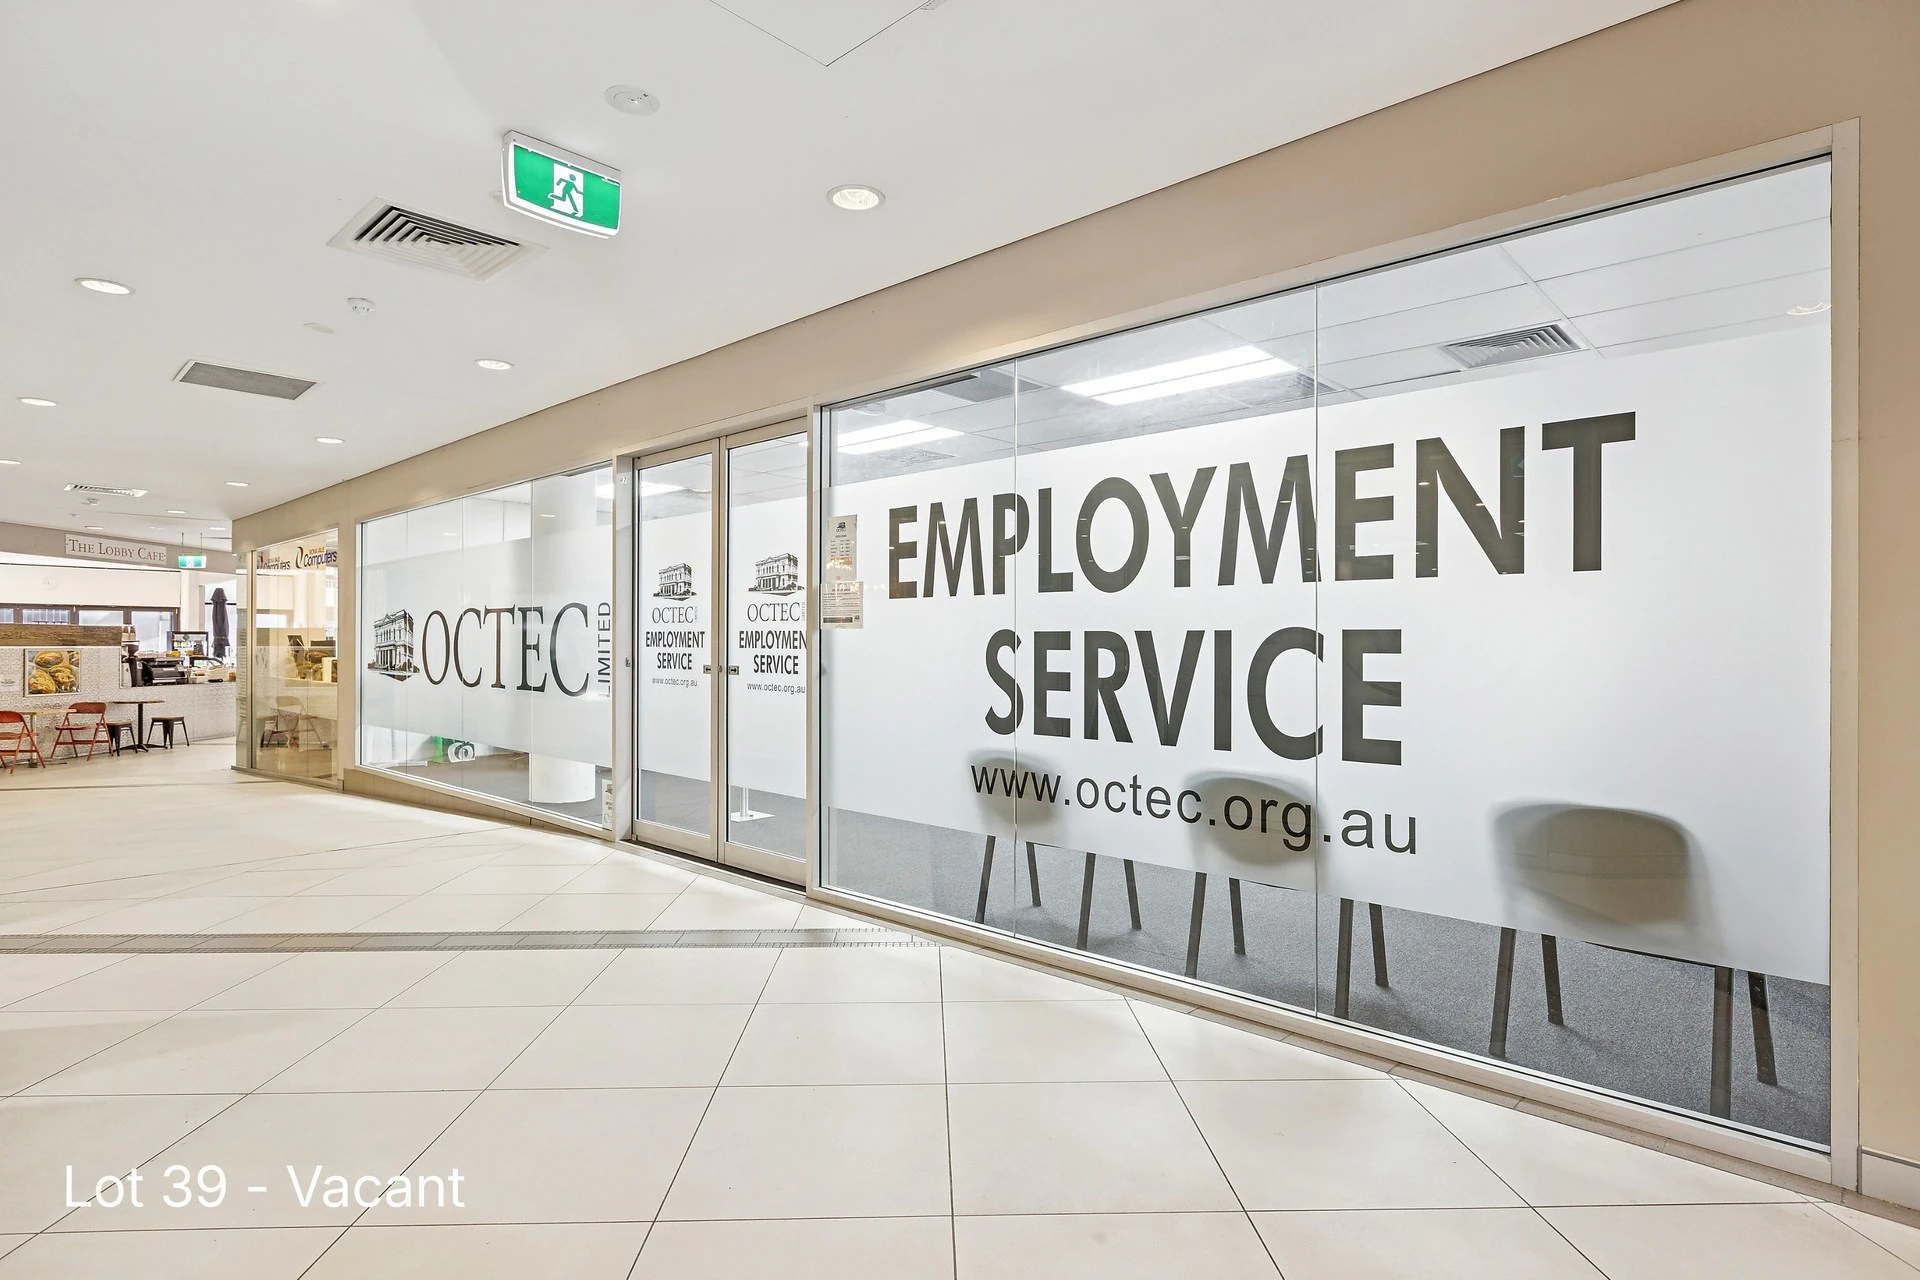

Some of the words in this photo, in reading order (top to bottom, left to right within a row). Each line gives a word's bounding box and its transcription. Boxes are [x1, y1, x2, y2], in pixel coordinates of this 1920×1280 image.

[888, 411, 1636, 599] EMPLOYMENT
[69, 538, 95, 554] THE
[98, 542, 135, 558] LOBBY
[303, 550, 338, 569] Computers
[651, 606, 694, 624] OCTEC
[747, 602, 801, 622] OCTEC
[421, 602, 590, 697] OCTEC
[597, 602, 611, 698] LIMITED
[645, 631, 706, 649] EMPLOYMENT
[739, 630, 808, 650] EMPLOYMEN
[656, 652, 693, 671] SERVICE
[753, 655, 799, 675] SERVICE
[651, 677, 698, 689] www.octec.org.au
[746, 682, 806, 695] www.octec.org.au
[984, 626, 1402, 766] SERVICE
[969, 764, 1417, 855] www.octec.org.au
